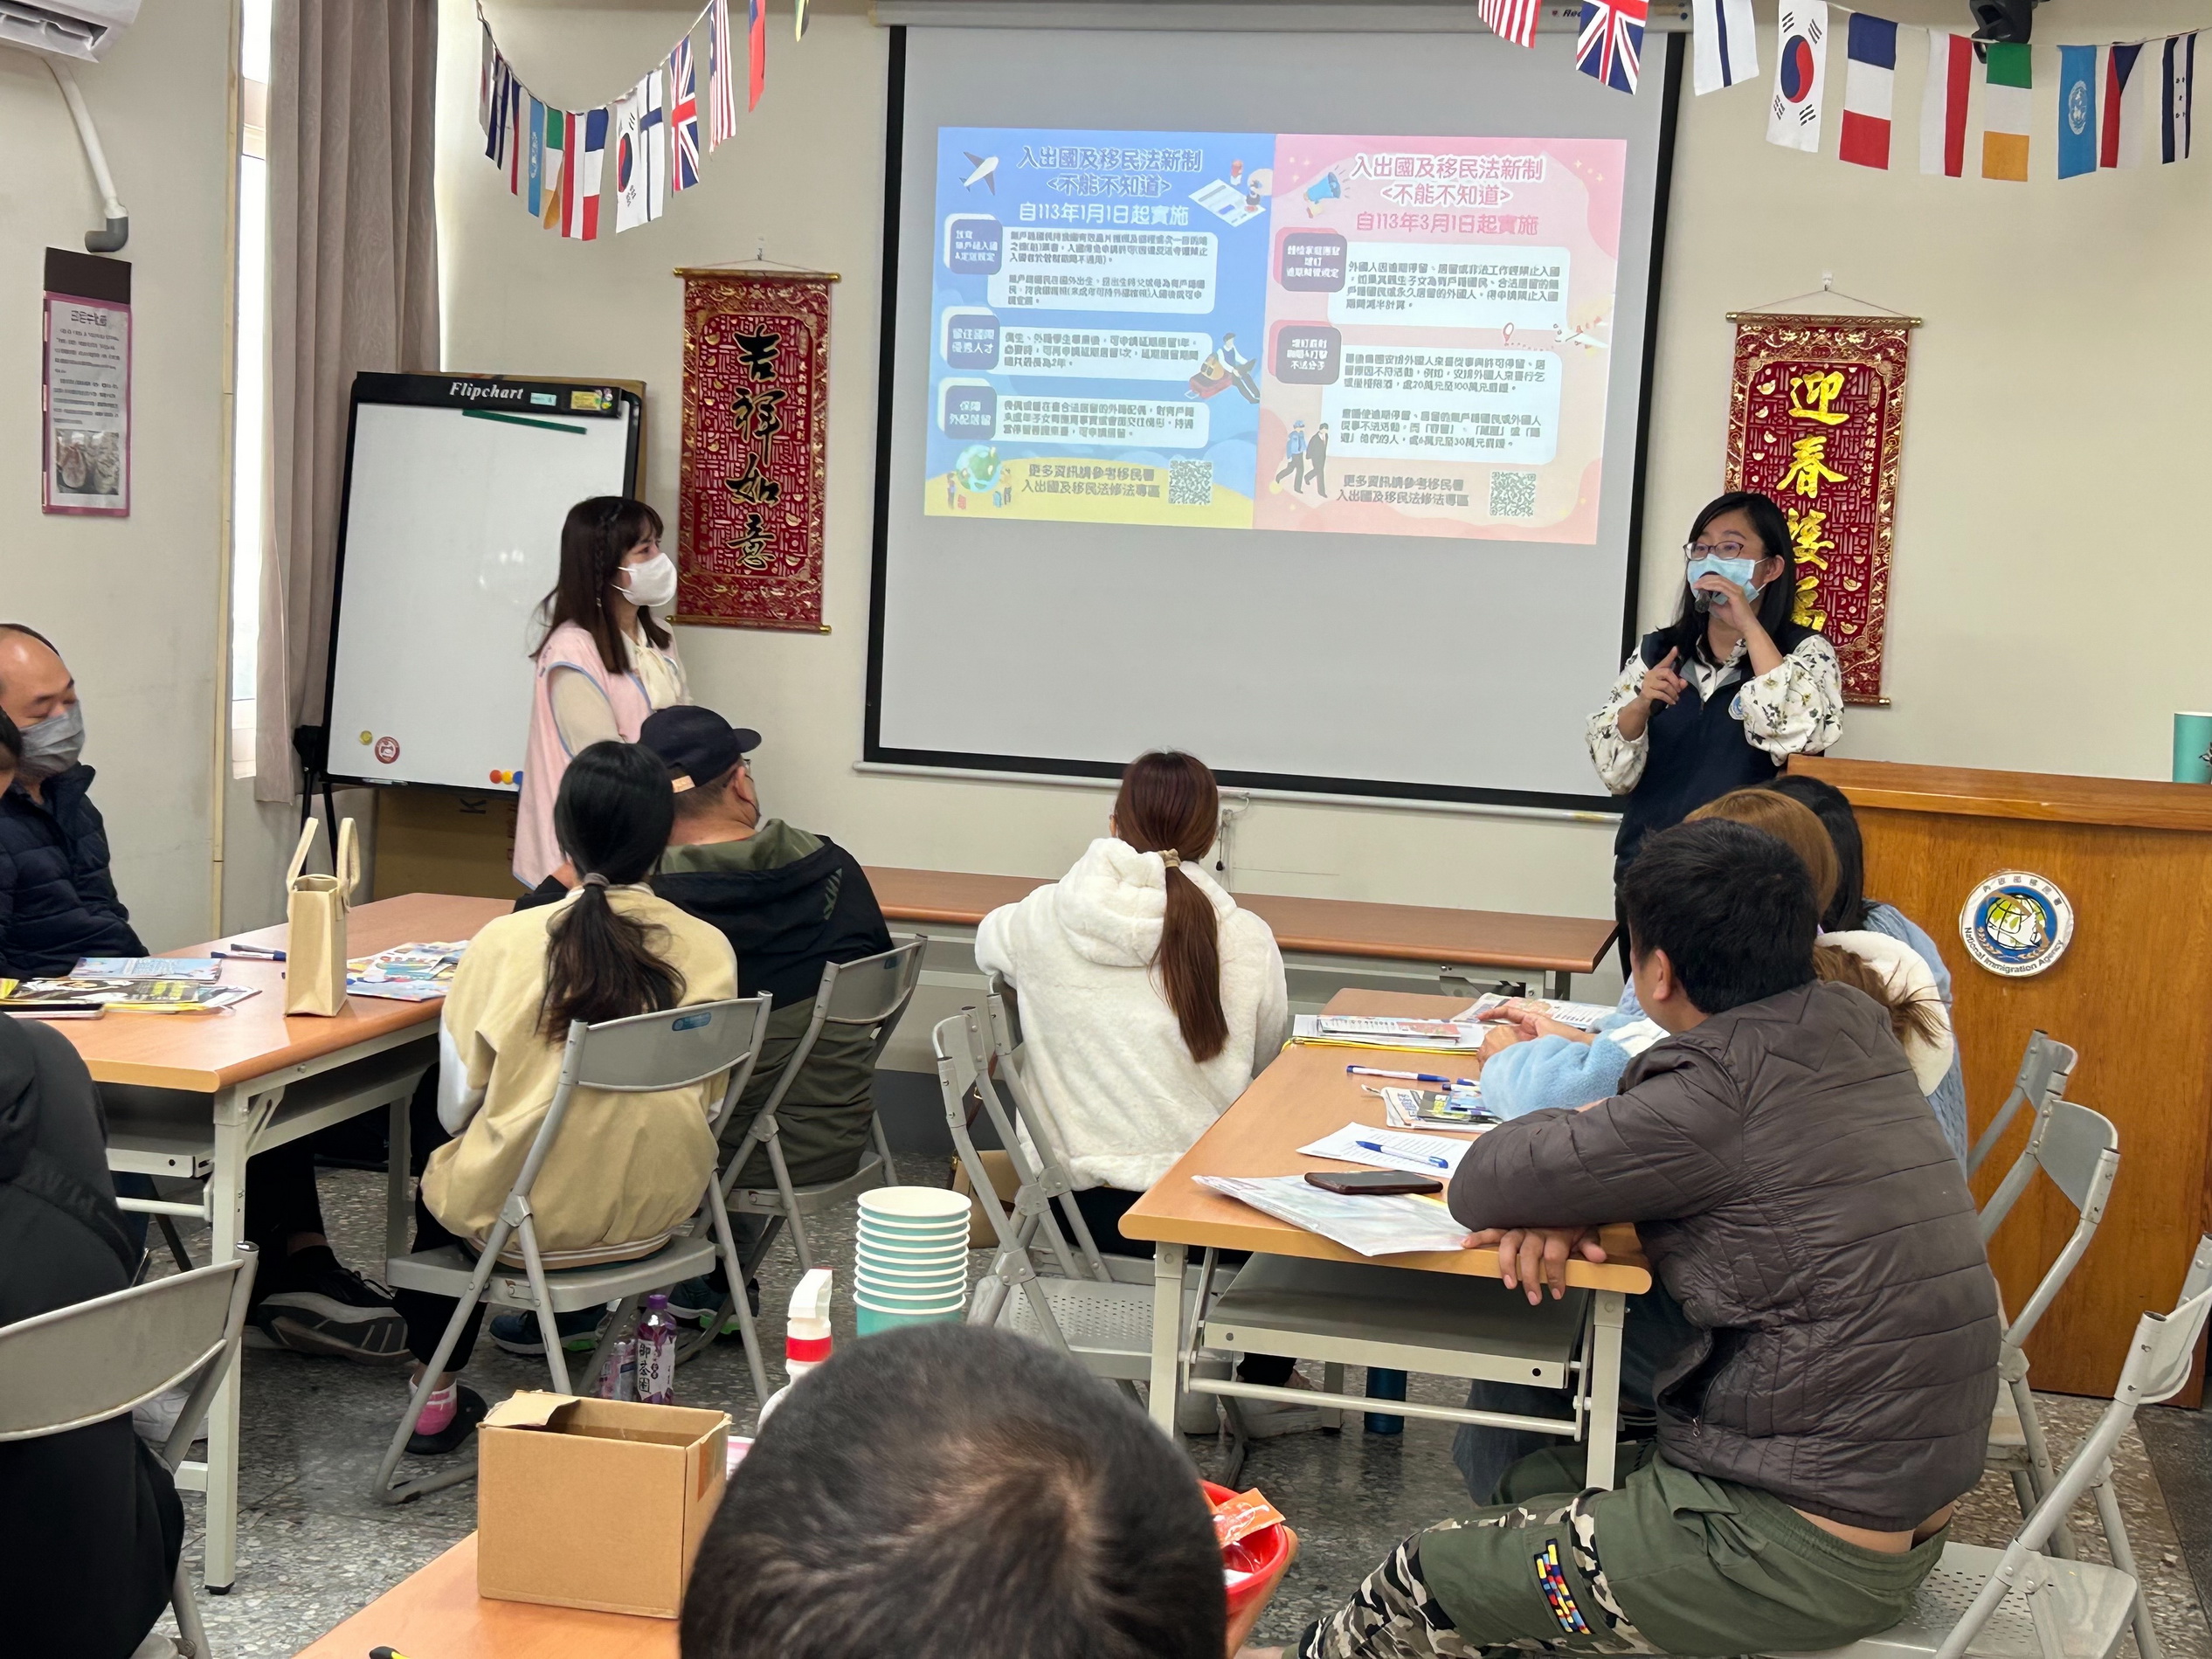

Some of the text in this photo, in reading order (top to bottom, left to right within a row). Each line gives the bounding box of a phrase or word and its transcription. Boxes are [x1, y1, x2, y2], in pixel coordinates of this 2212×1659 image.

[1018, 146, 1202, 173] 入出國及移民法新制
[1351, 155, 1545, 182] 入出國及移民法新制
[1020, 203, 1189, 226] 自113年1月1日起實施
[1357, 212, 1539, 236] 自113年3月1日起實施
[449, 382, 524, 401] Flipchart
[724, 322, 788, 571] 吉祥如意
[1964, 927, 2064, 974] National Immigration Agency
